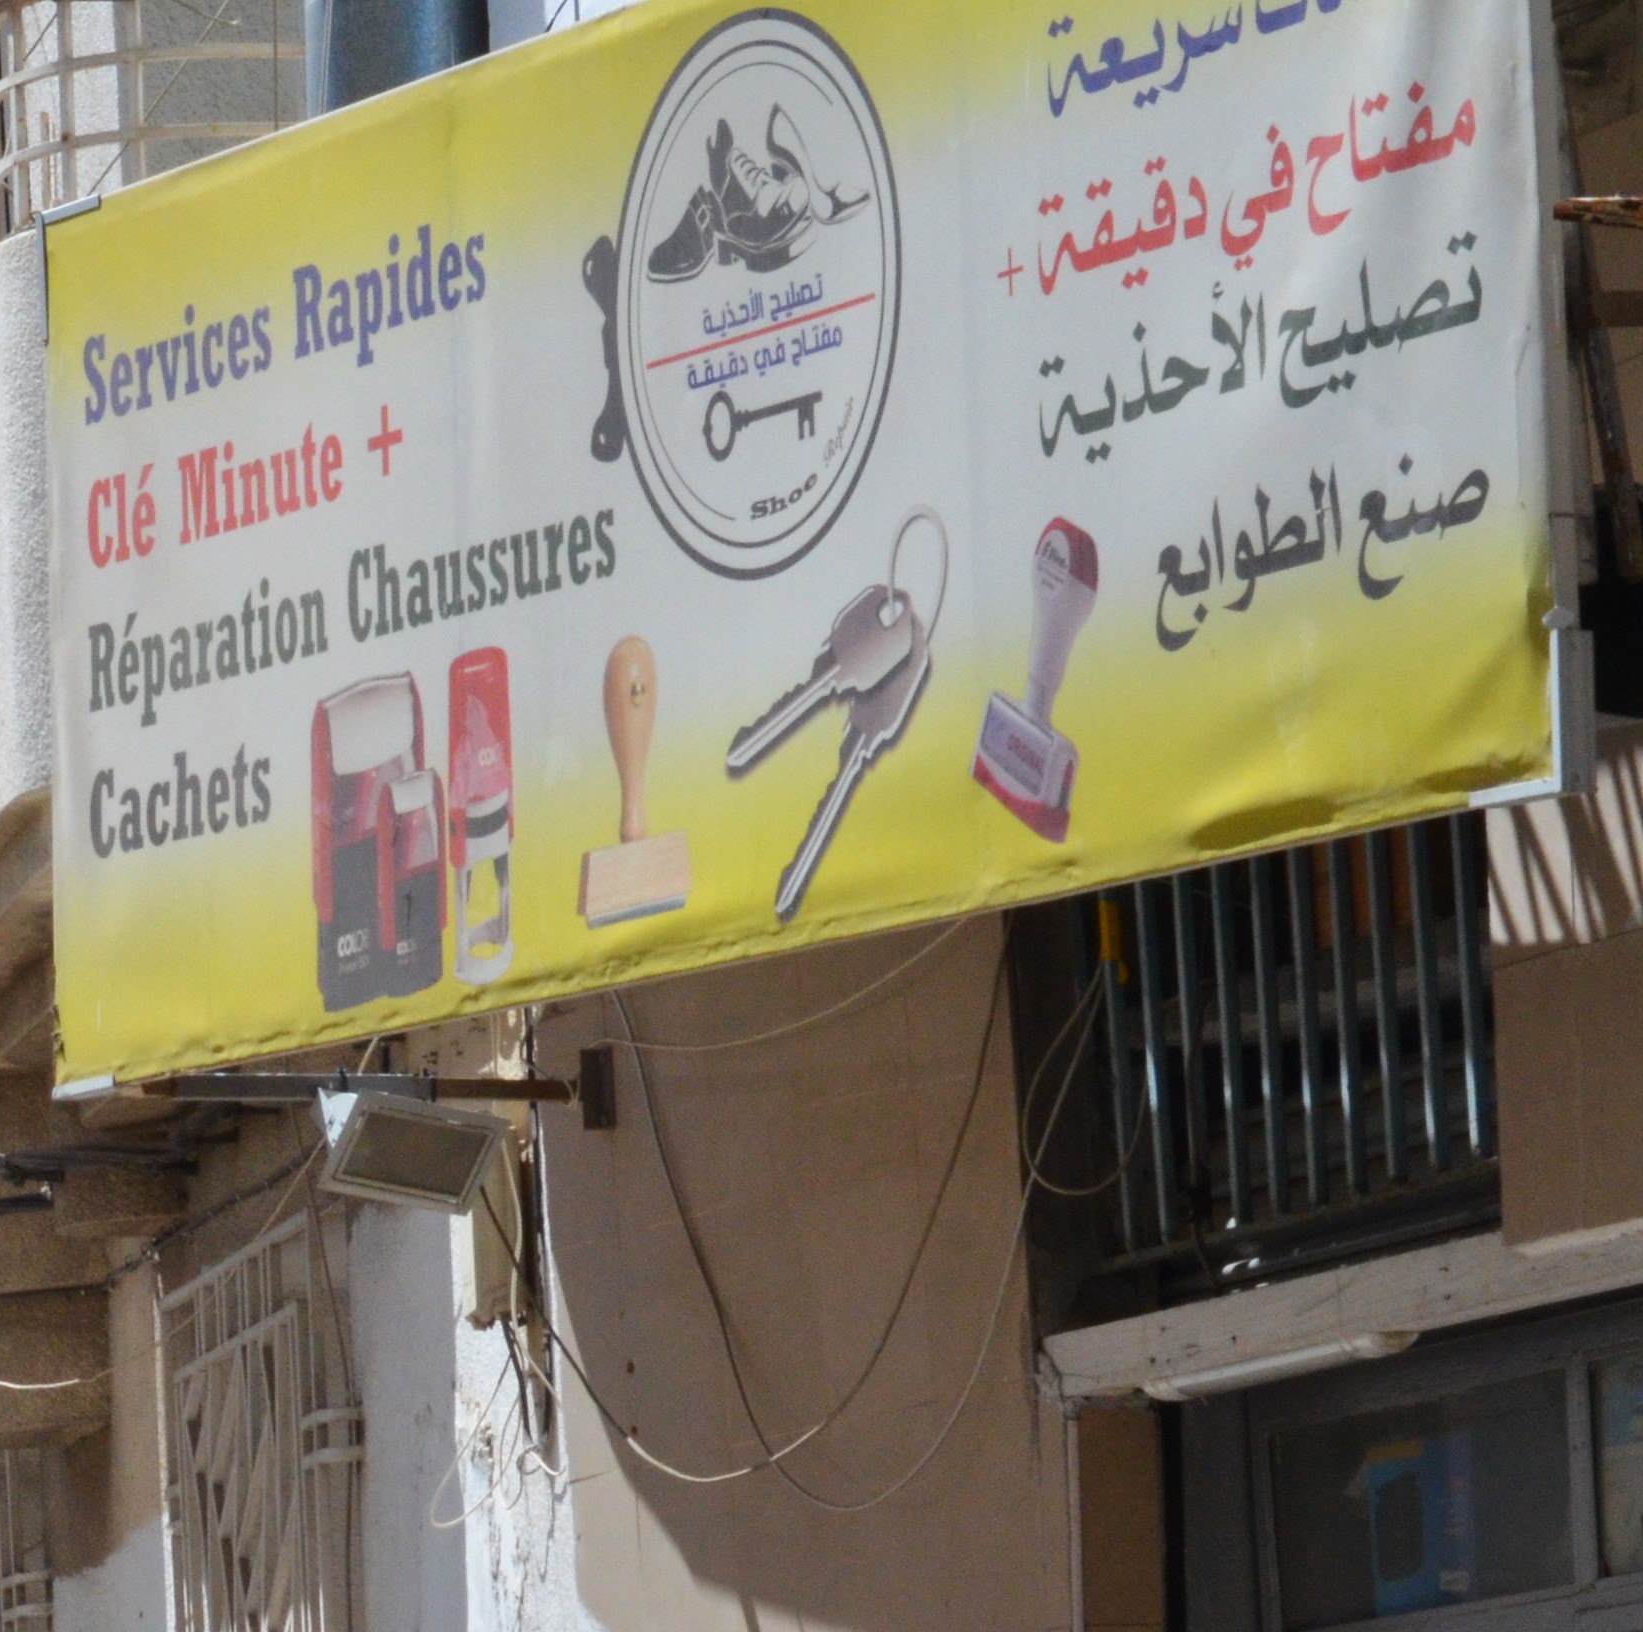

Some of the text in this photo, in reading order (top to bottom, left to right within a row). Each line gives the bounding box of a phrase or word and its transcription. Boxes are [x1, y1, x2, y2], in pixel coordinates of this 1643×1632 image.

[1048, 2, 1242, 118] سريعة
[1037, 156, 1207, 295] دقيقة
[1221, 123, 1294, 271] في
[1305, 80, 1476, 236] مفتاح
[82, 224, 486, 426] Services Rapides
[687, 323, 843, 389] مفتاح في دقيقة
[703, 273, 823, 337] تصليح الأحذية
[1038, 231, 1482, 465] تصليح الأحذية
[88, 462, 156, 569] Clé
[178, 421, 343, 545] Minute
[750, 473, 817, 520] Shoe
[1156, 452, 1490, 651] صنع الطوابع
[88, 508, 615, 728] Réparation Chaussures
[90, 743, 271, 859] Cachets
